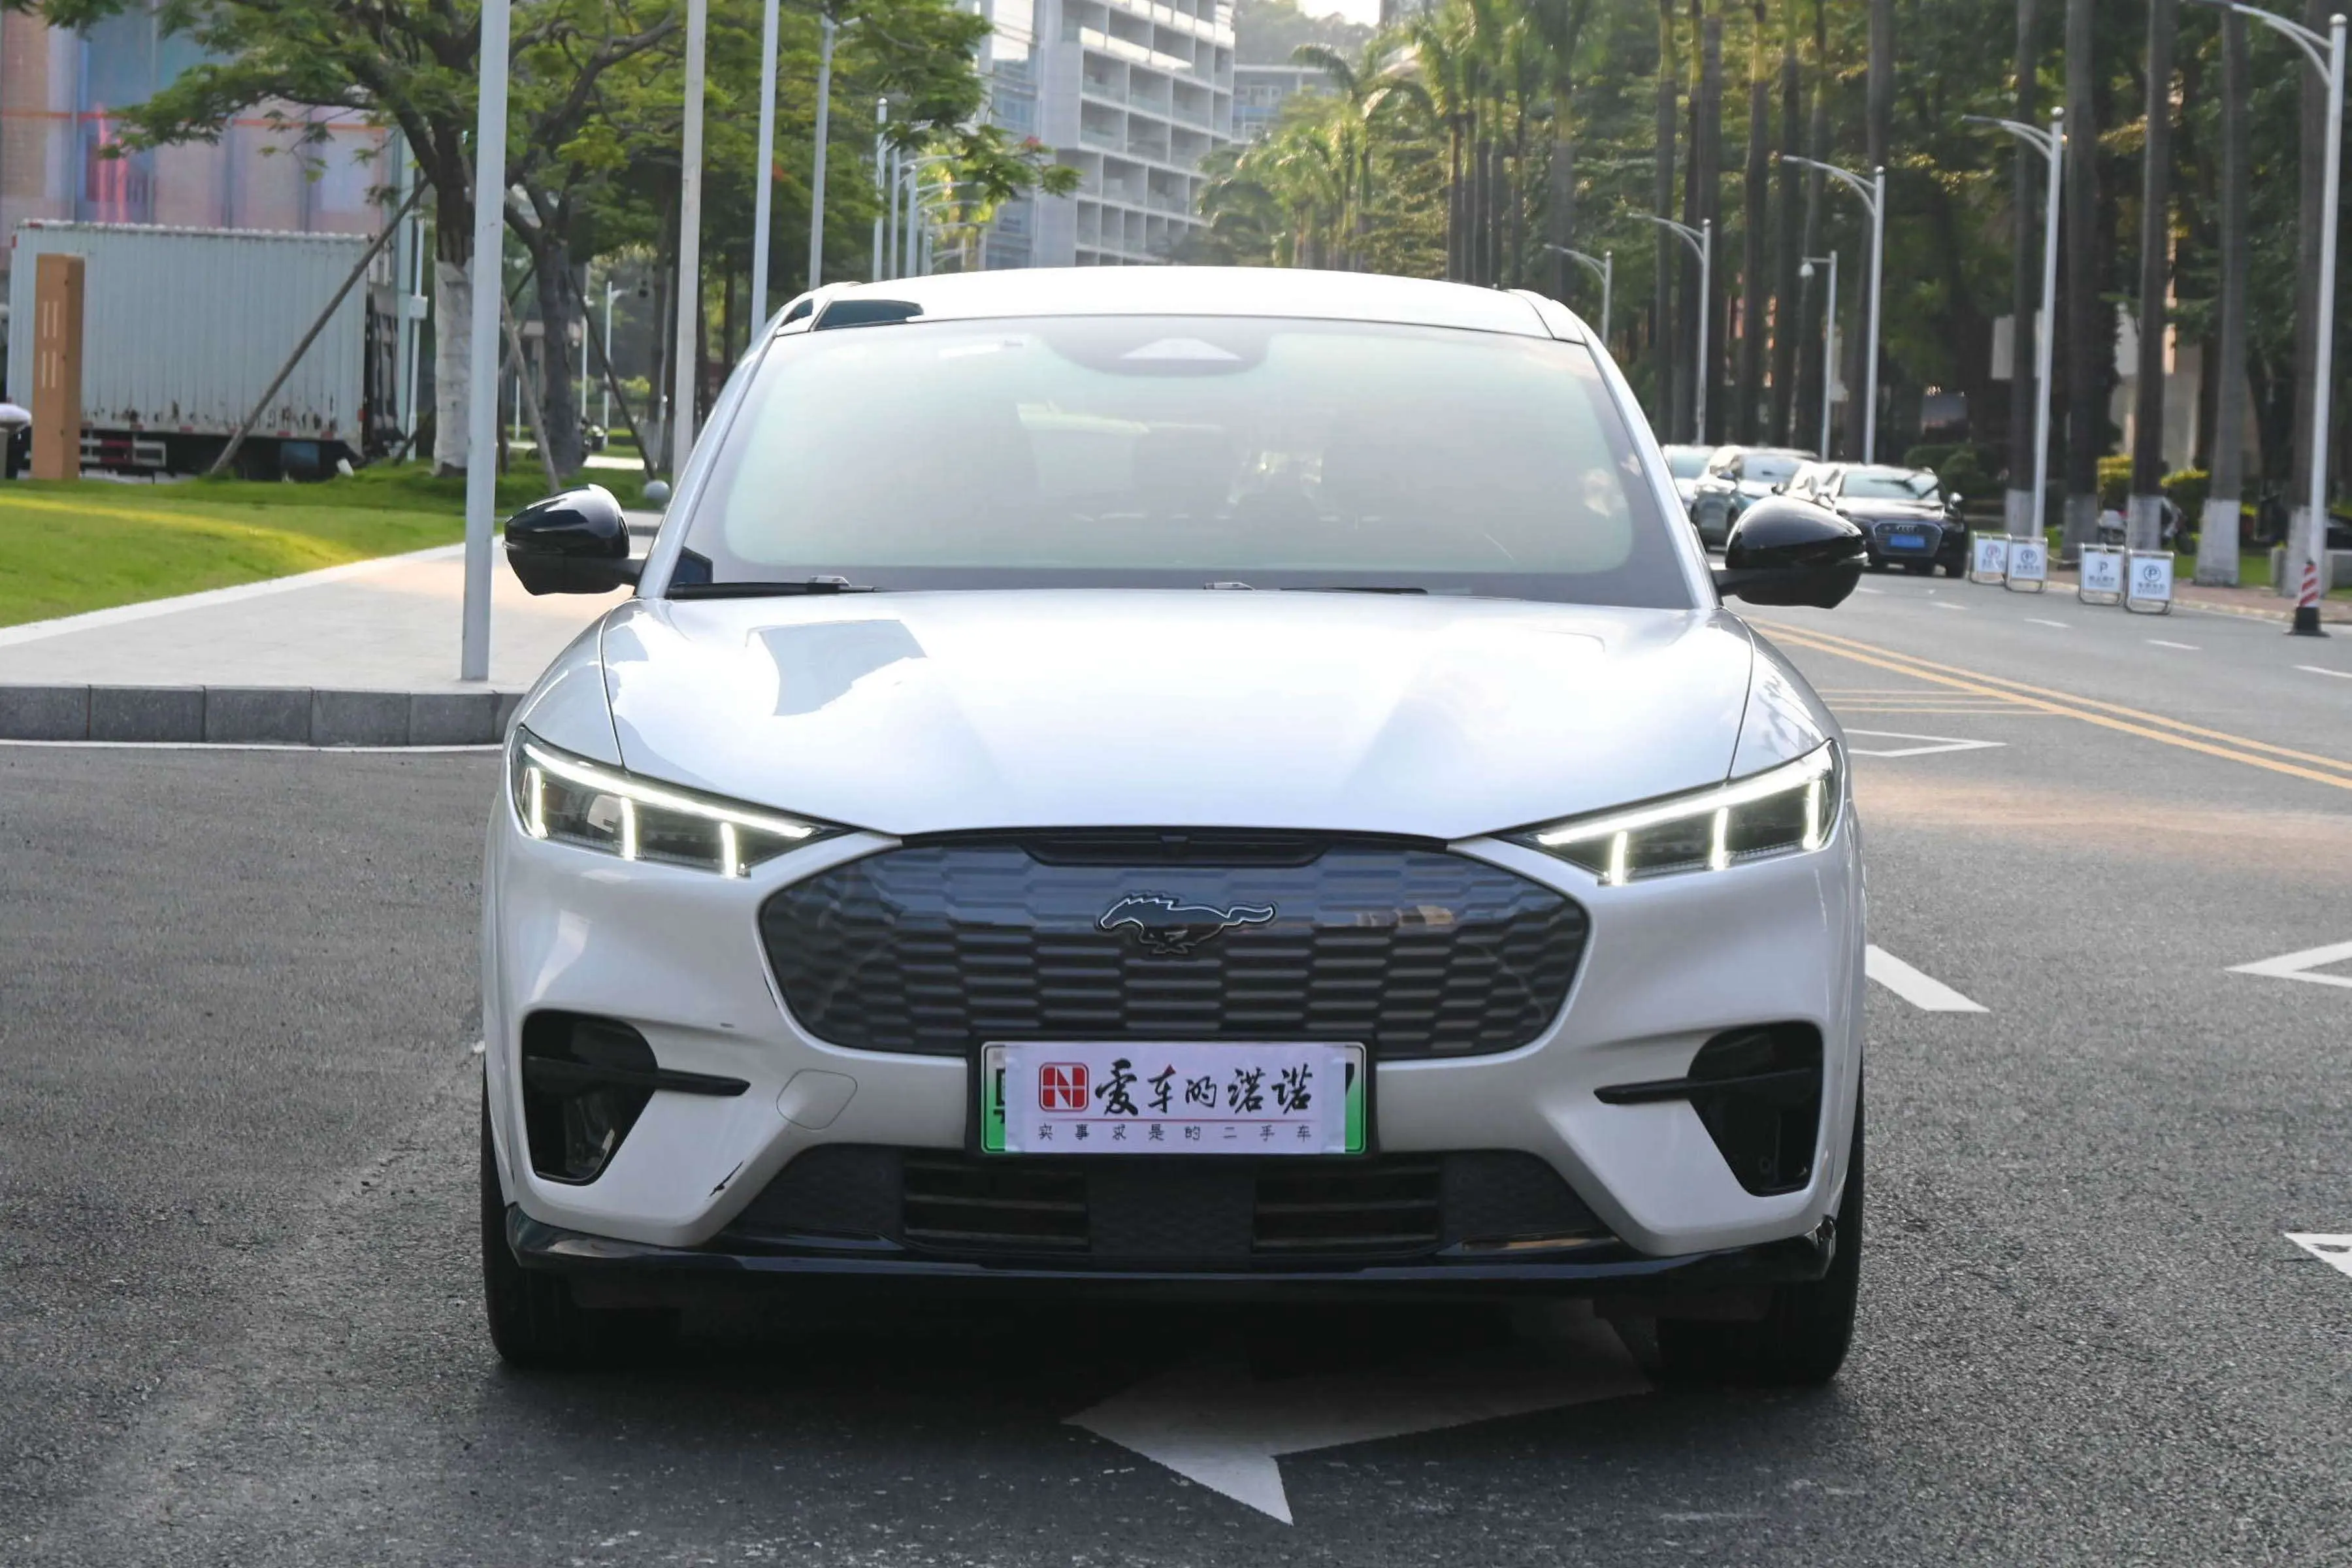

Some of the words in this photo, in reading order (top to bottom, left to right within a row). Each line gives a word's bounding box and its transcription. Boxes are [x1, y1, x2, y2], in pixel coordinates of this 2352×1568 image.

[2100, 561, 2108, 573] P
[1038, 1122, 1312, 1141] 实事求是的二手车
